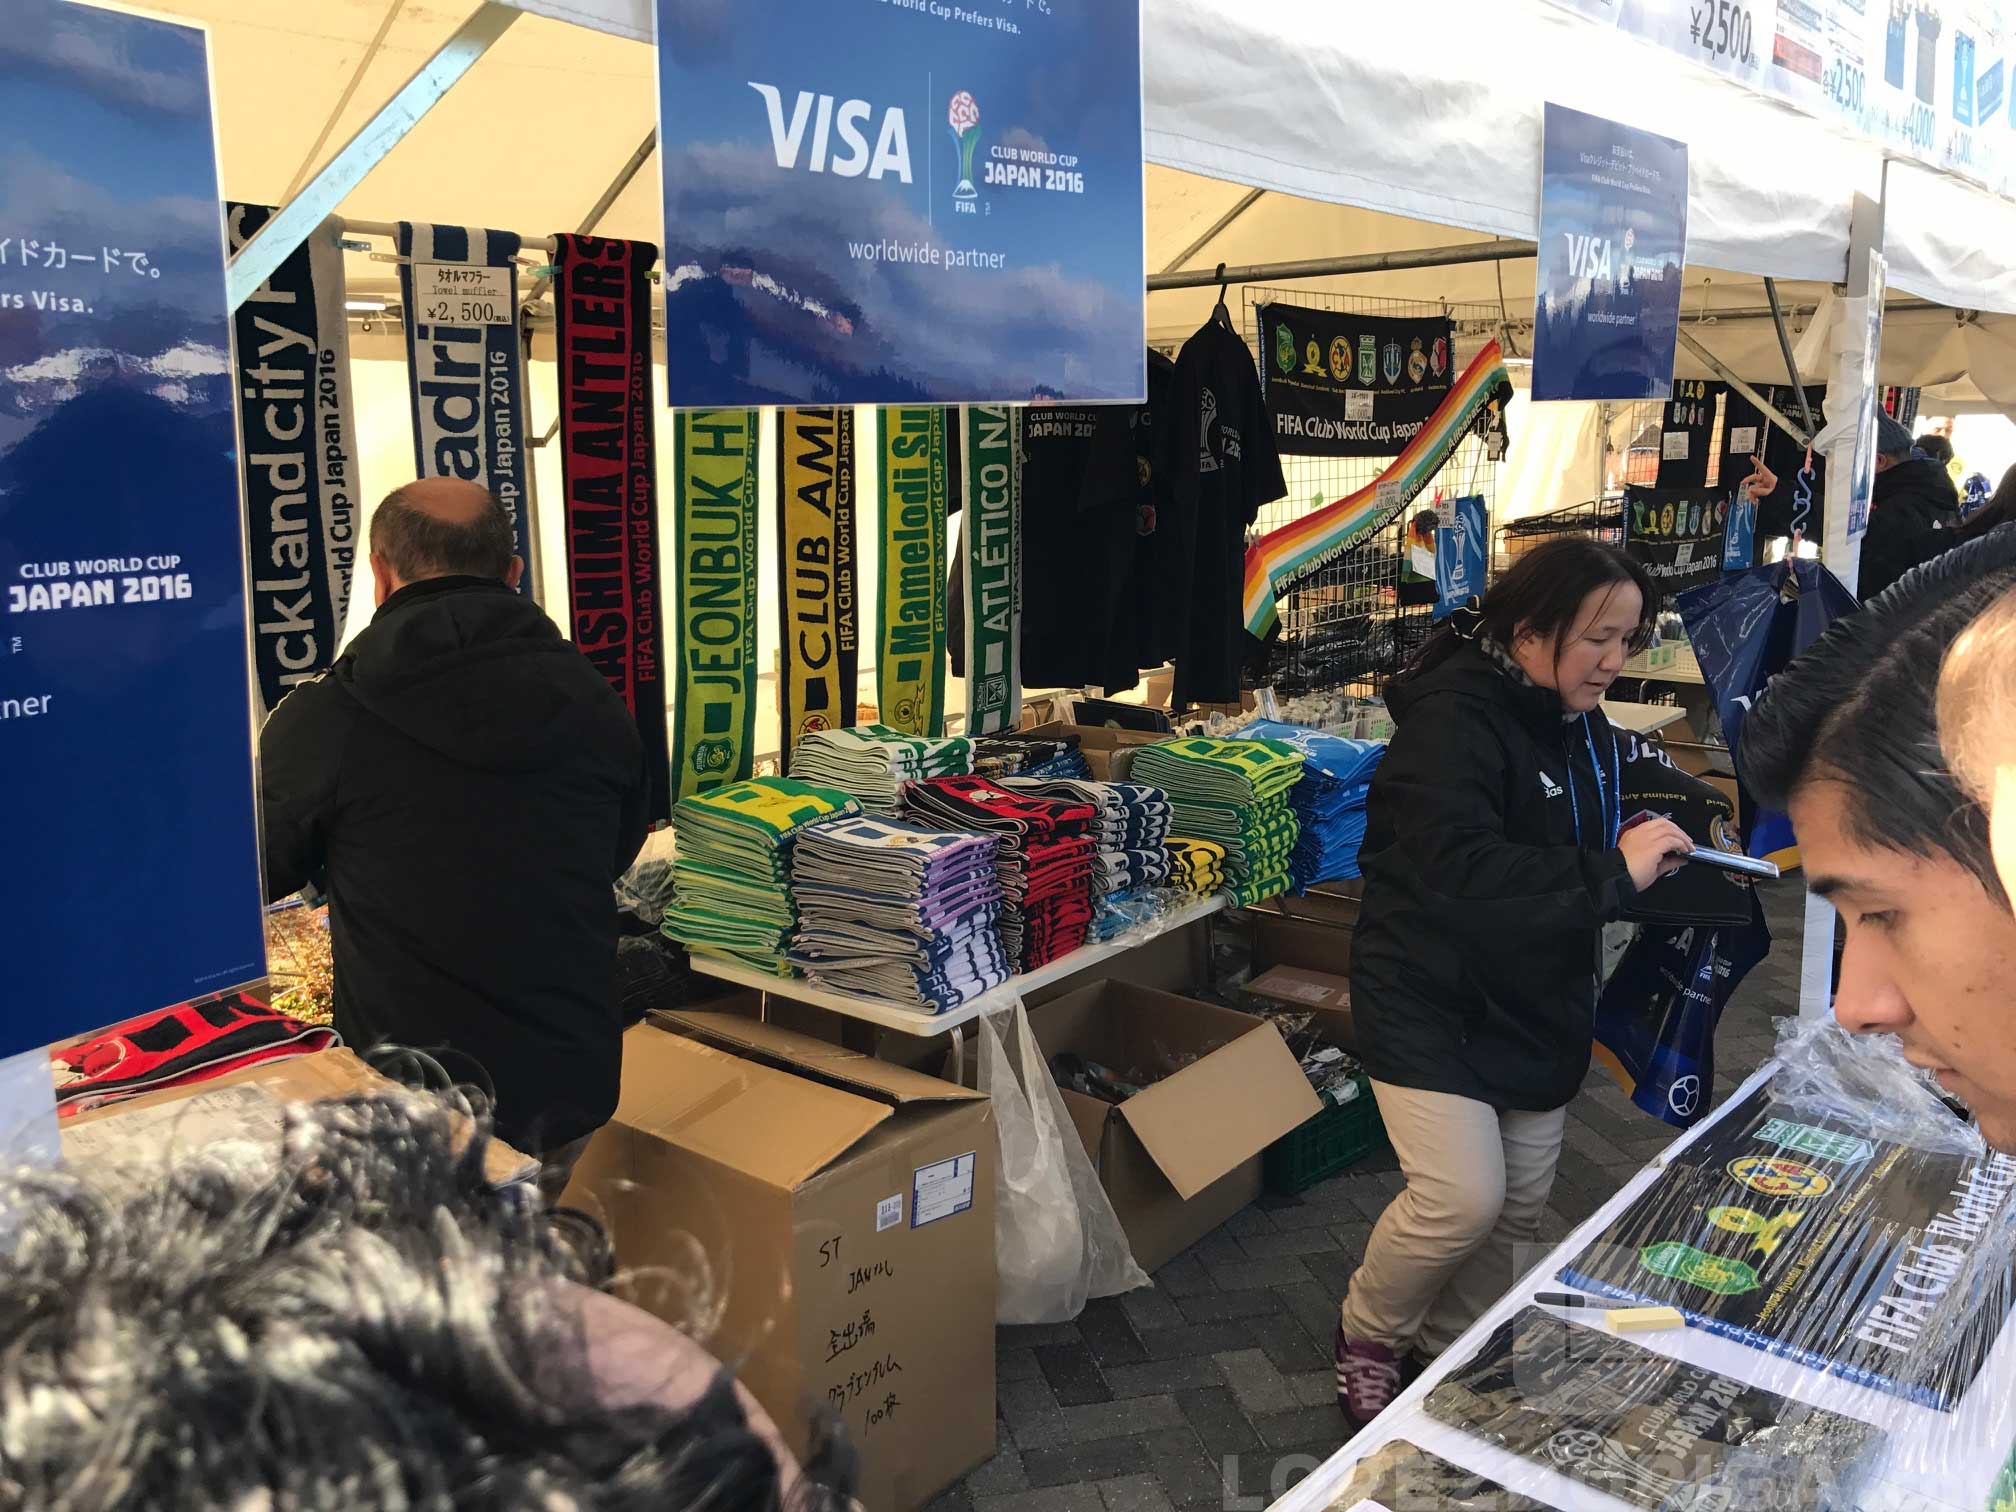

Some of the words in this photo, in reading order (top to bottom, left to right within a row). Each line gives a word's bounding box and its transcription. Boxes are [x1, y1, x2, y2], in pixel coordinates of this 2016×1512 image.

[930, 2, 951, 20] Cup
[954, 7, 993, 28] Prefers
[996, 17, 1021, 35] Visa.
[1690, 0, 1752, 63] ¥2,500
[747, 81, 912, 184] VISA
[984, 162, 1041, 189] JAPAN
[1045, 169, 1084, 193] 2016
[991, 146, 1019, 160] CLUB
[1020, 149, 1057, 165] WORLD
[1057, 154, 1078, 168] CUP
[955, 200, 976, 214] FIFA
[438, 268, 491, 284] タオルマフラー
[849, 239, 940, 264] worldwide
[945, 249, 1006, 270] partner
[1564, 233, 1611, 280] VISA
[32, 291, 94, 314] Visa.
[427, 301, 494, 324] ¥2,500
[432, 286, 458, 295] Towel
[462, 286, 498, 296] muffler
[1588, 312, 1615, 325] worldwide
[1616, 313, 1635, 326] partner
[571, 236, 627, 459] ANTLERS
[244, 315, 318, 441] city
[319, 350, 338, 409] 2016
[490, 351, 510, 405] 2016
[631, 352, 645, 401] 2016
[418, 325, 482, 480] adri
[1031, 412, 1053, 421] CLUB
[1055, 411, 1085, 421] WORLD
[324, 413, 347, 488] Japan
[494, 409, 516, 478] Japan
[631, 405, 649, 468] Japan
[1029, 422, 1072, 438] JAPAN
[1276, 414, 1304, 436] FIFA
[1305, 416, 1334, 439] Club
[1333, 421, 1367, 440] World
[1368, 421, 1390, 444] Cup
[1392, 420, 1423, 442] Japan
[631, 475, 651, 516] Cup
[743, 469, 754, 513] Cup
[837, 471, 851, 500] Cup
[934, 460, 945, 488] Cup
[330, 493, 354, 543] Cup
[837, 499, 850, 566] World
[934, 496, 945, 555] World
[1013, 486, 1021, 539] World
[631, 520, 651, 584] World
[743, 516, 755, 575] World
[973, 464, 1009, 632] ATLÉTICO
[1275, 572, 1297, 593] FIFA
[1298, 556, 1321, 579] Club
[1320, 541, 1354, 564] World
[1352, 526, 1374, 545] Cup
[1373, 505, 1402, 531] Japan
[1400, 480, 1419, 504] 2016
[20, 561, 70, 578] CLUB
[75, 557, 143, 575] WORLD
[146, 555, 181, 570] CUP
[572, 472, 628, 697] ASHIMA
[890, 468, 931, 656] Mamelodi
[935, 558, 945, 597] Club
[1685, 560, 1702, 576] Japan
[1702, 555, 1718, 570] 2016
[8, 578, 115, 613] JAPAN
[123, 573, 193, 603] 2016
[689, 475, 744, 695] JEONBUK
[796, 536, 832, 670] CLUB
[838, 570, 852, 611] Club
[637, 589, 653, 635] Club
[841, 612, 855, 652] FIFA
[935, 601, 945, 632] FIFA
[637, 637, 656, 681] FIFA
[818, 812, 829, 823] Cup
[1642, 792, 1687, 801] Kashima
[1928, 1181, 2008, 1242] World
[819, 1236, 841, 1267] ST
[1894, 1243, 1967, 1296] Club
[1602, 1284, 1636, 1304] FIFA
[1685, 1311, 1744, 1340] World
[1745, 1332, 1781, 1352] Cup
[1853, 1282, 1937, 1354] FIFA
[1638, 1408, 1670, 1438] CLUB
